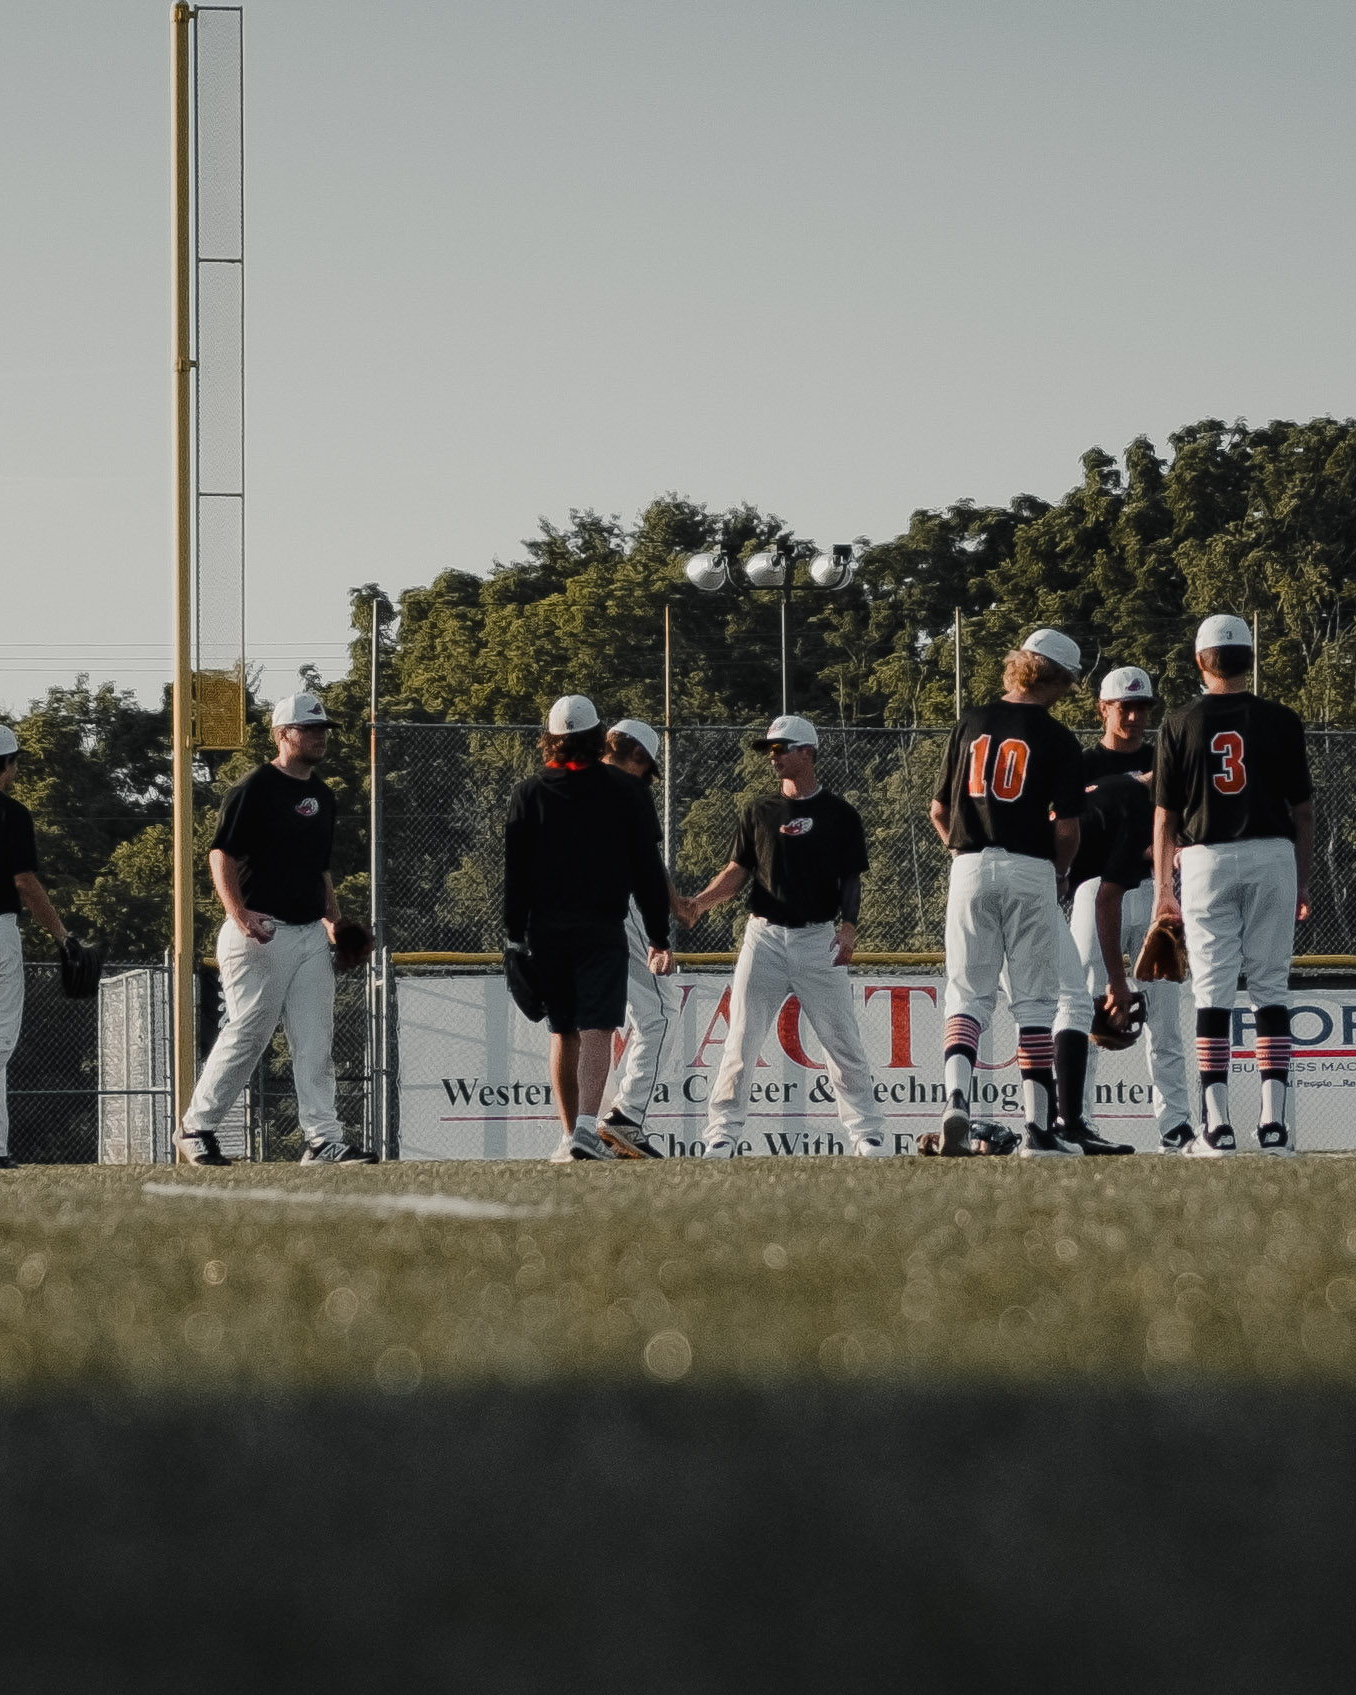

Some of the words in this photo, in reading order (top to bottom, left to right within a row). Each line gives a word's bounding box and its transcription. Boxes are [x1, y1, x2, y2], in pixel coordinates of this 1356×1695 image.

[968, 734, 1031, 802] 10
[1210, 730, 1247, 795] 3
[441, 1077, 554, 1107] Wester
[682, 1073, 799, 1104] Ceer
[808, 1074, 835, 1103] &
[871, 1074, 1032, 1112] echnlog
[1231, 1061, 1317, 1073] BUESS
